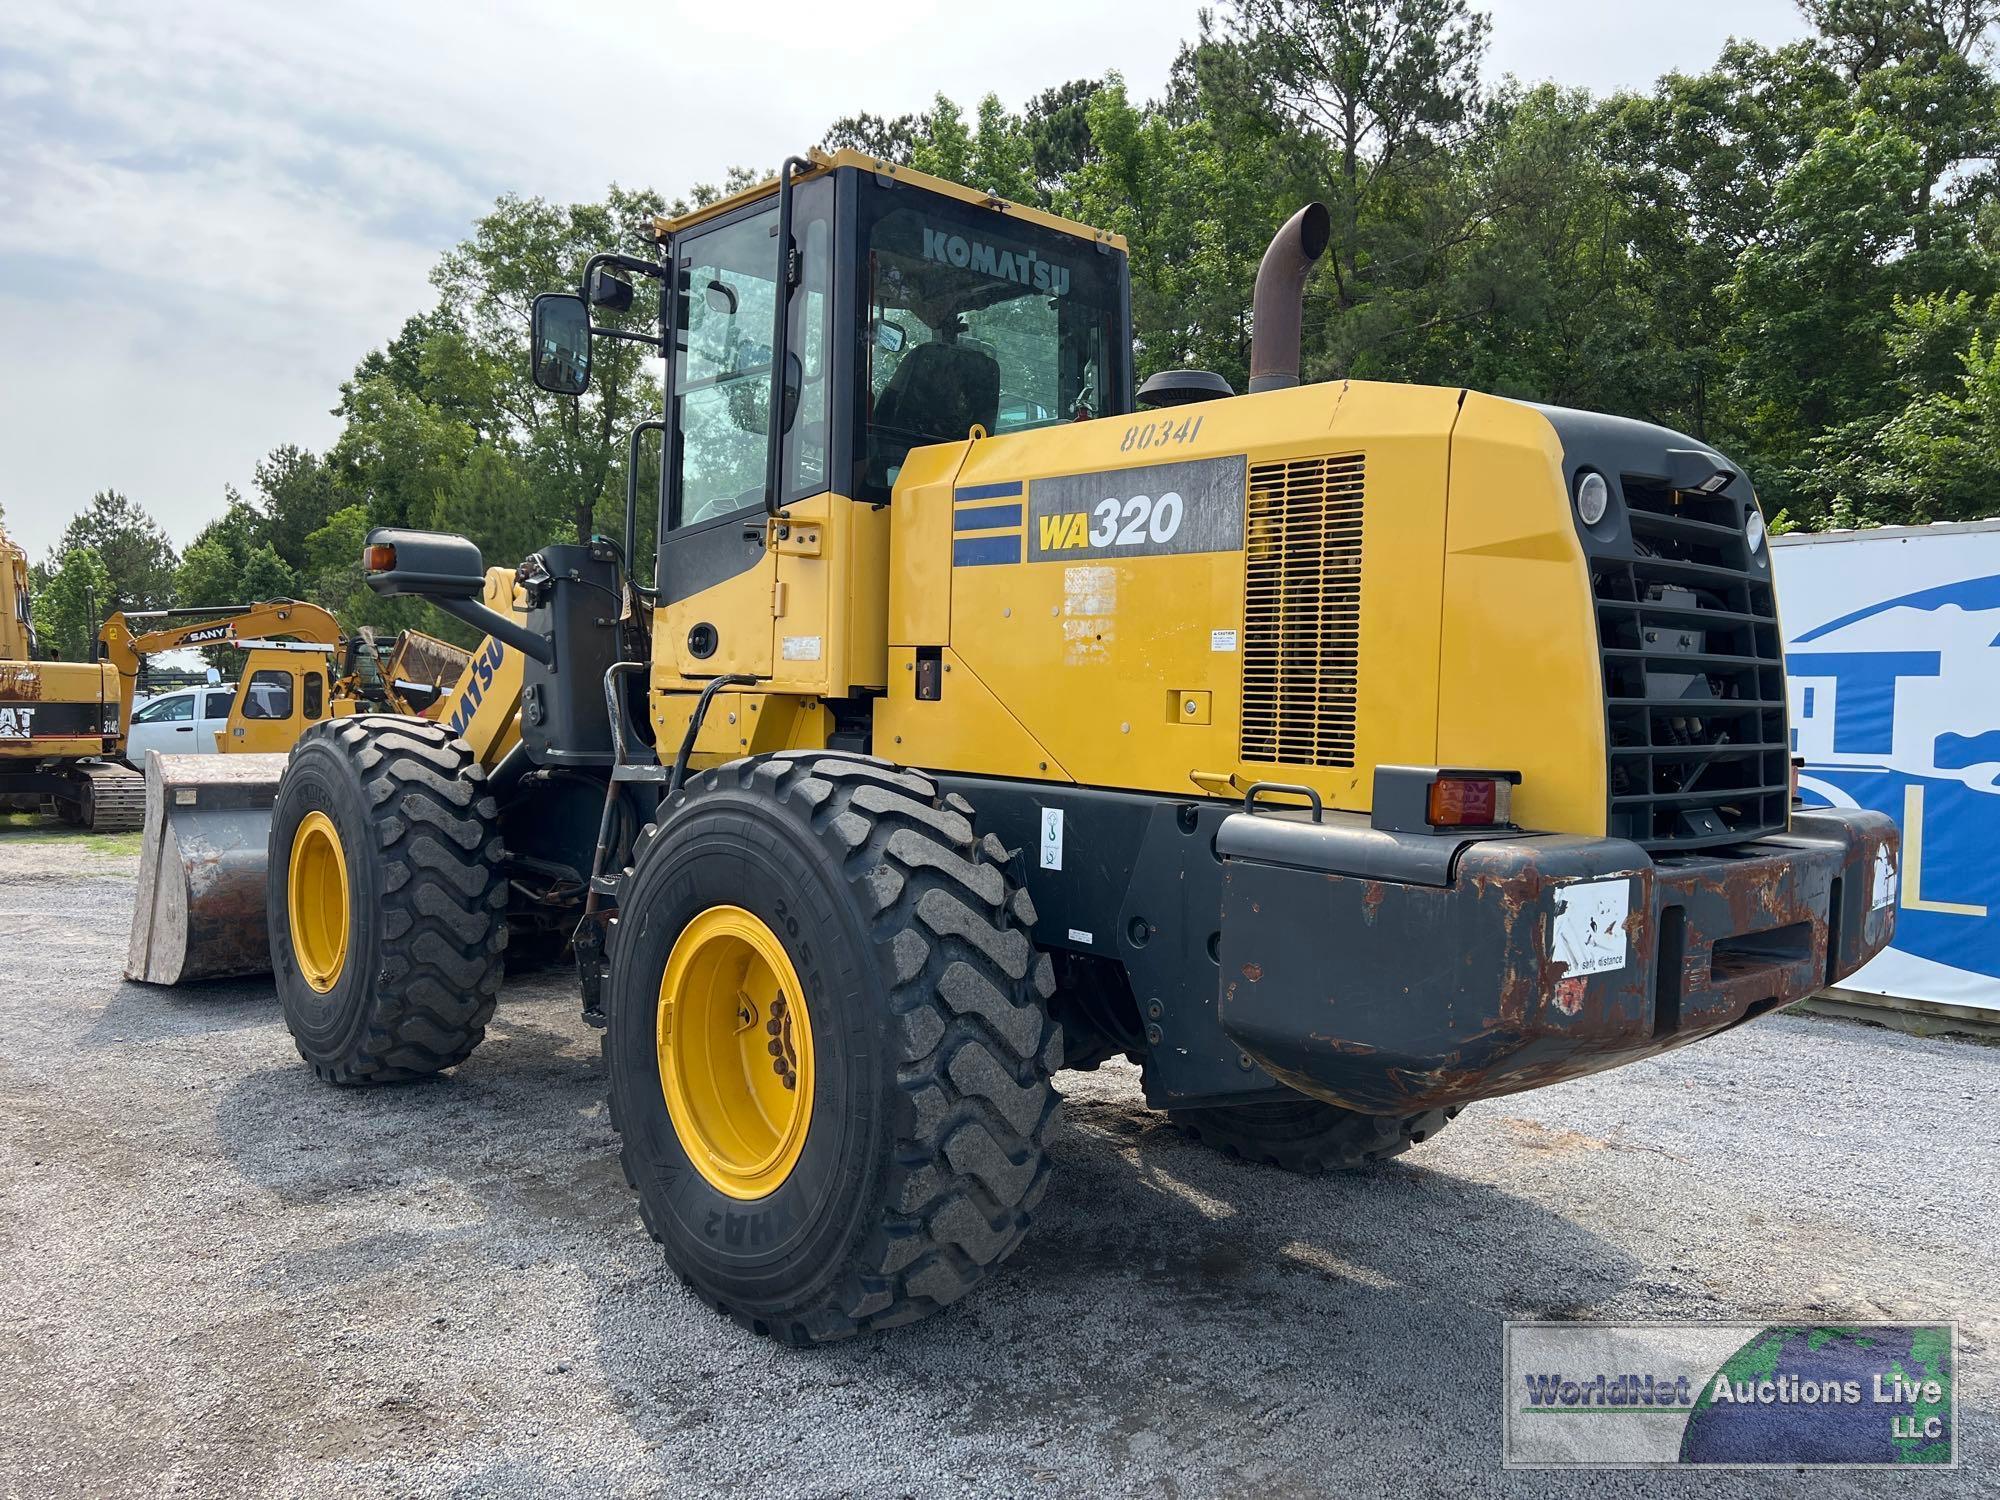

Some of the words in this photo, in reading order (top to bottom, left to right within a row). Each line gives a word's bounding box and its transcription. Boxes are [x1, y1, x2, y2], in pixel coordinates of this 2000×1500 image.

[924, 228, 1070, 296] KOMATSU
[1120, 416, 1204, 452] 80341
[1039, 491, 1184, 551] WA320
[190, 628, 224, 641] SANY
